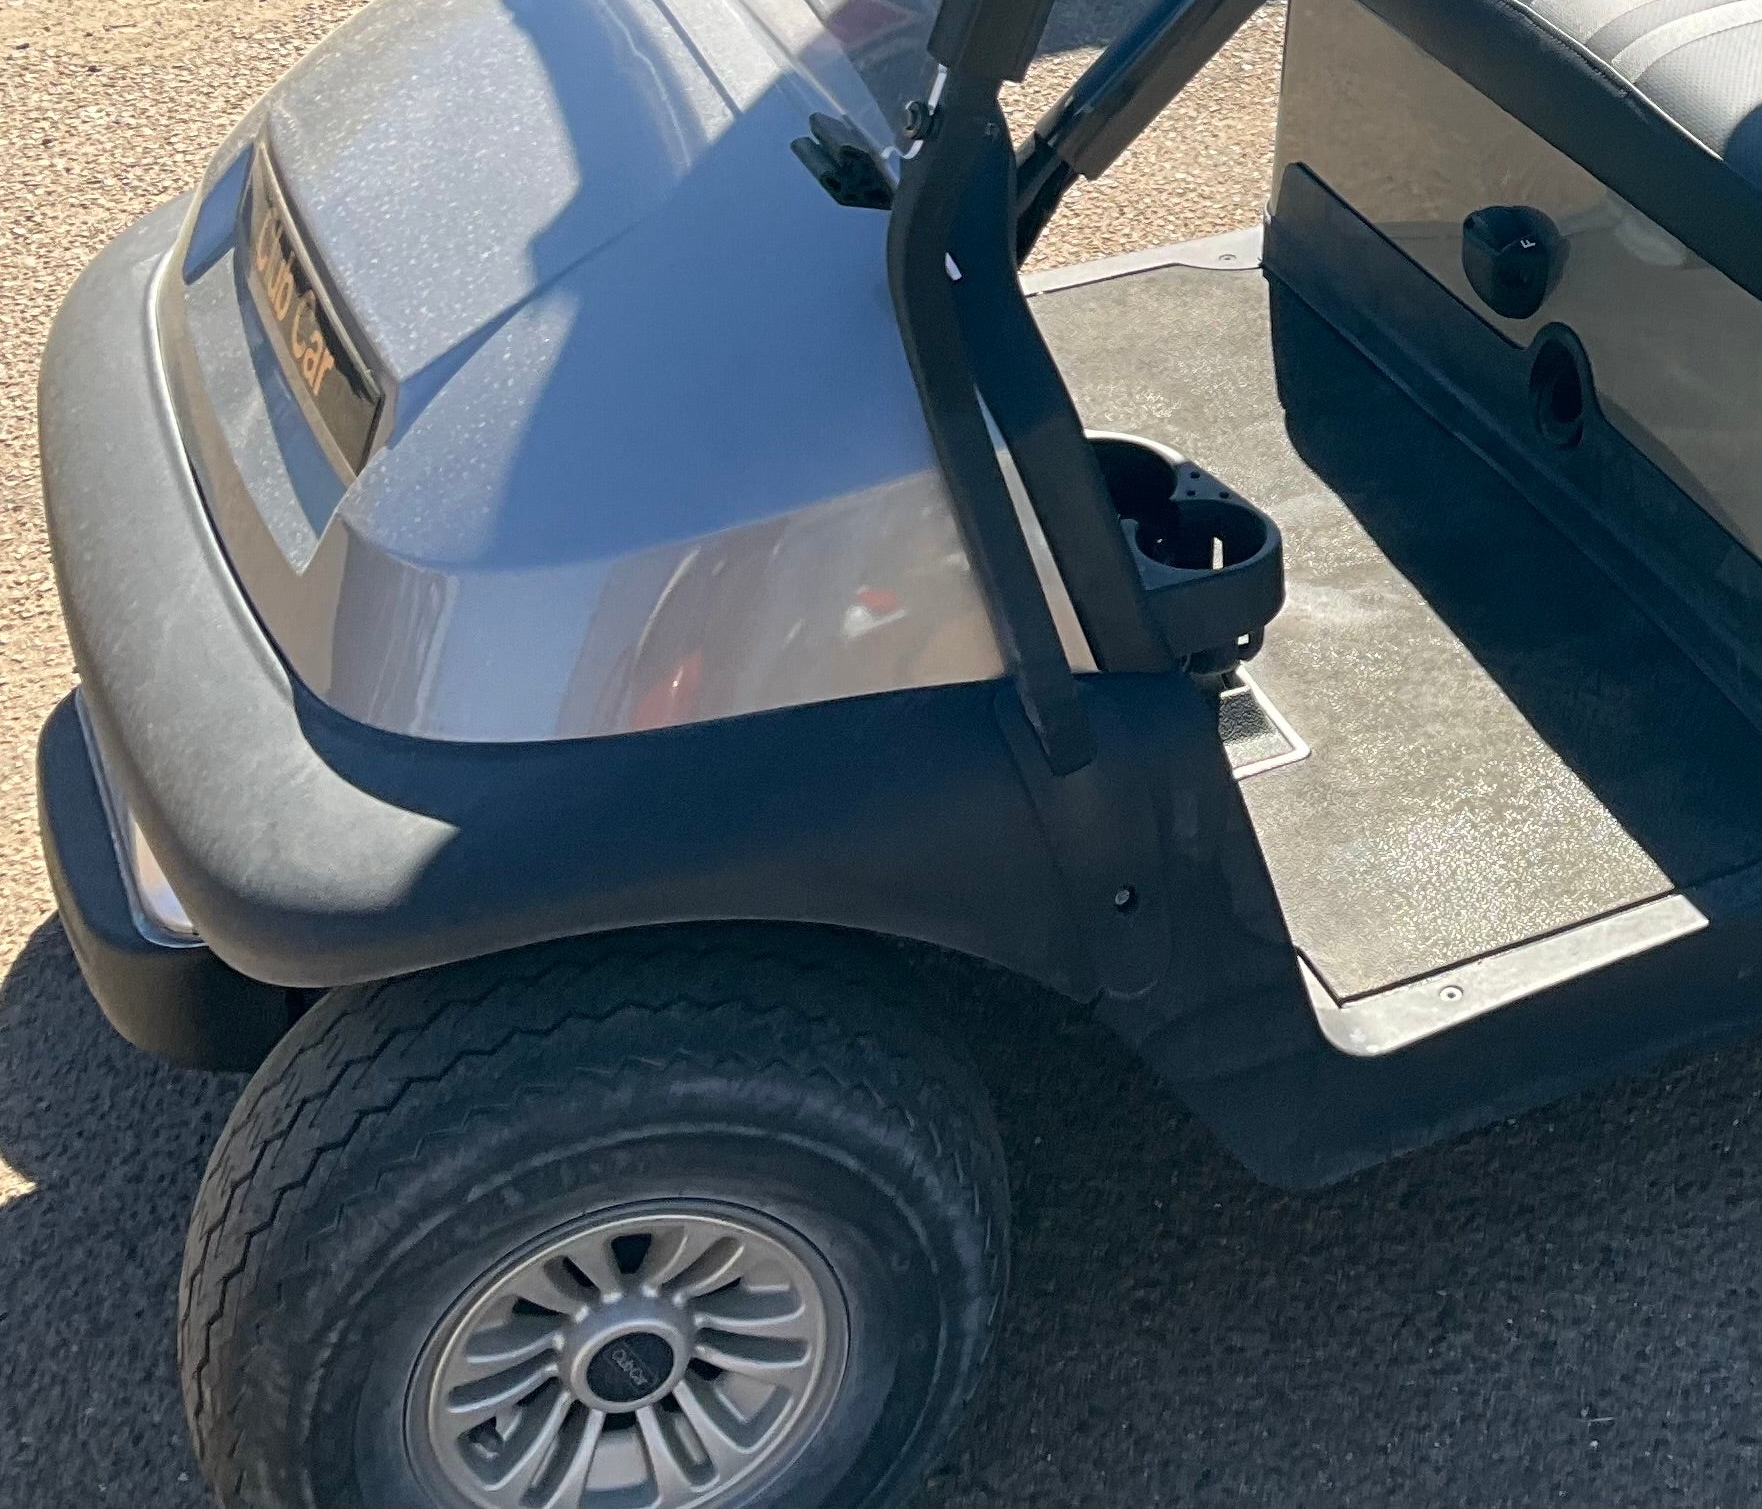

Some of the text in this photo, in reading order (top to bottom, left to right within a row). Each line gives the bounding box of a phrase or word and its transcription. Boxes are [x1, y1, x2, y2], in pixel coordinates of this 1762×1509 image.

[1520, 239, 1536, 249] F
[256, 208, 336, 396] Club Car
